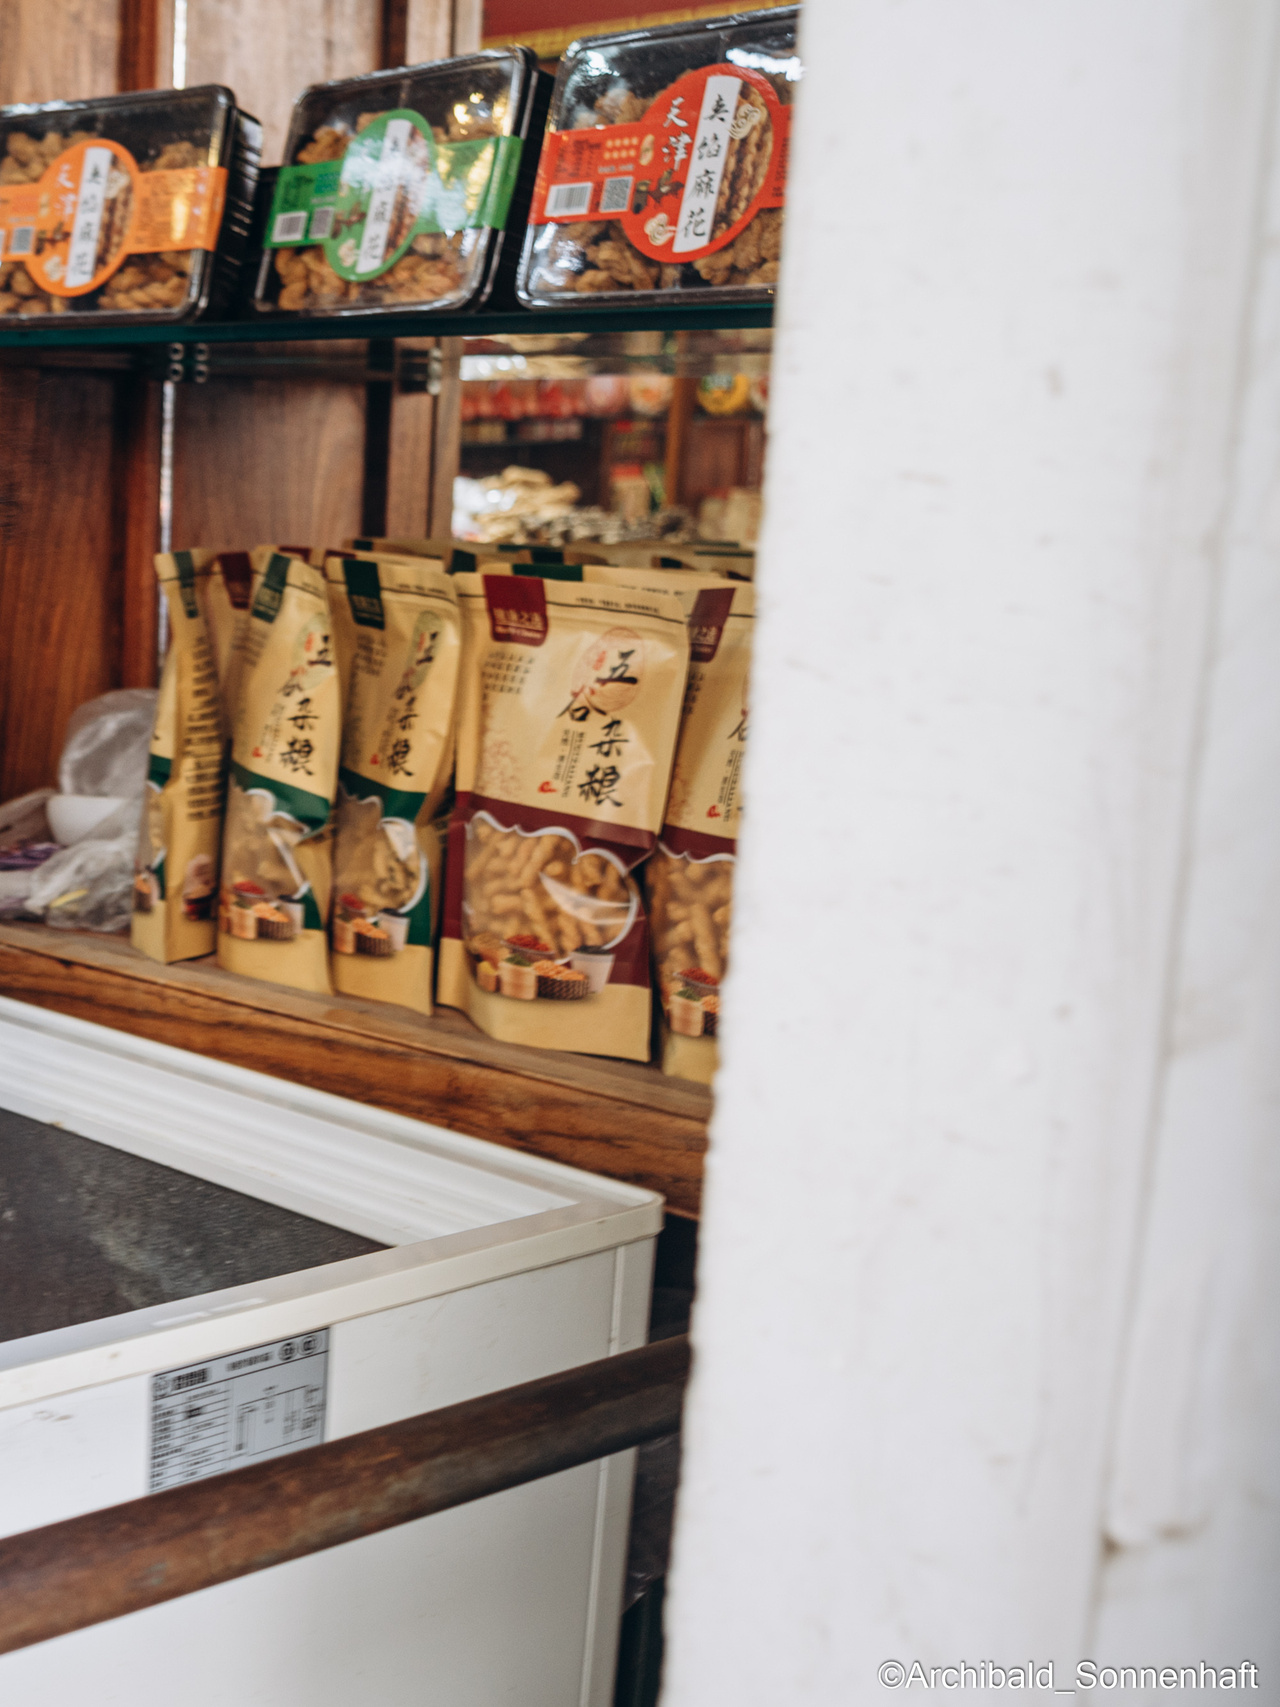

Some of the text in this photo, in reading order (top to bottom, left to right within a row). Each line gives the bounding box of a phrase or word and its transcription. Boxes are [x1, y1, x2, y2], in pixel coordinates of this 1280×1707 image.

[661, 96, 693, 171] 天津
[556, 649, 639, 807] 五谷杂粮
